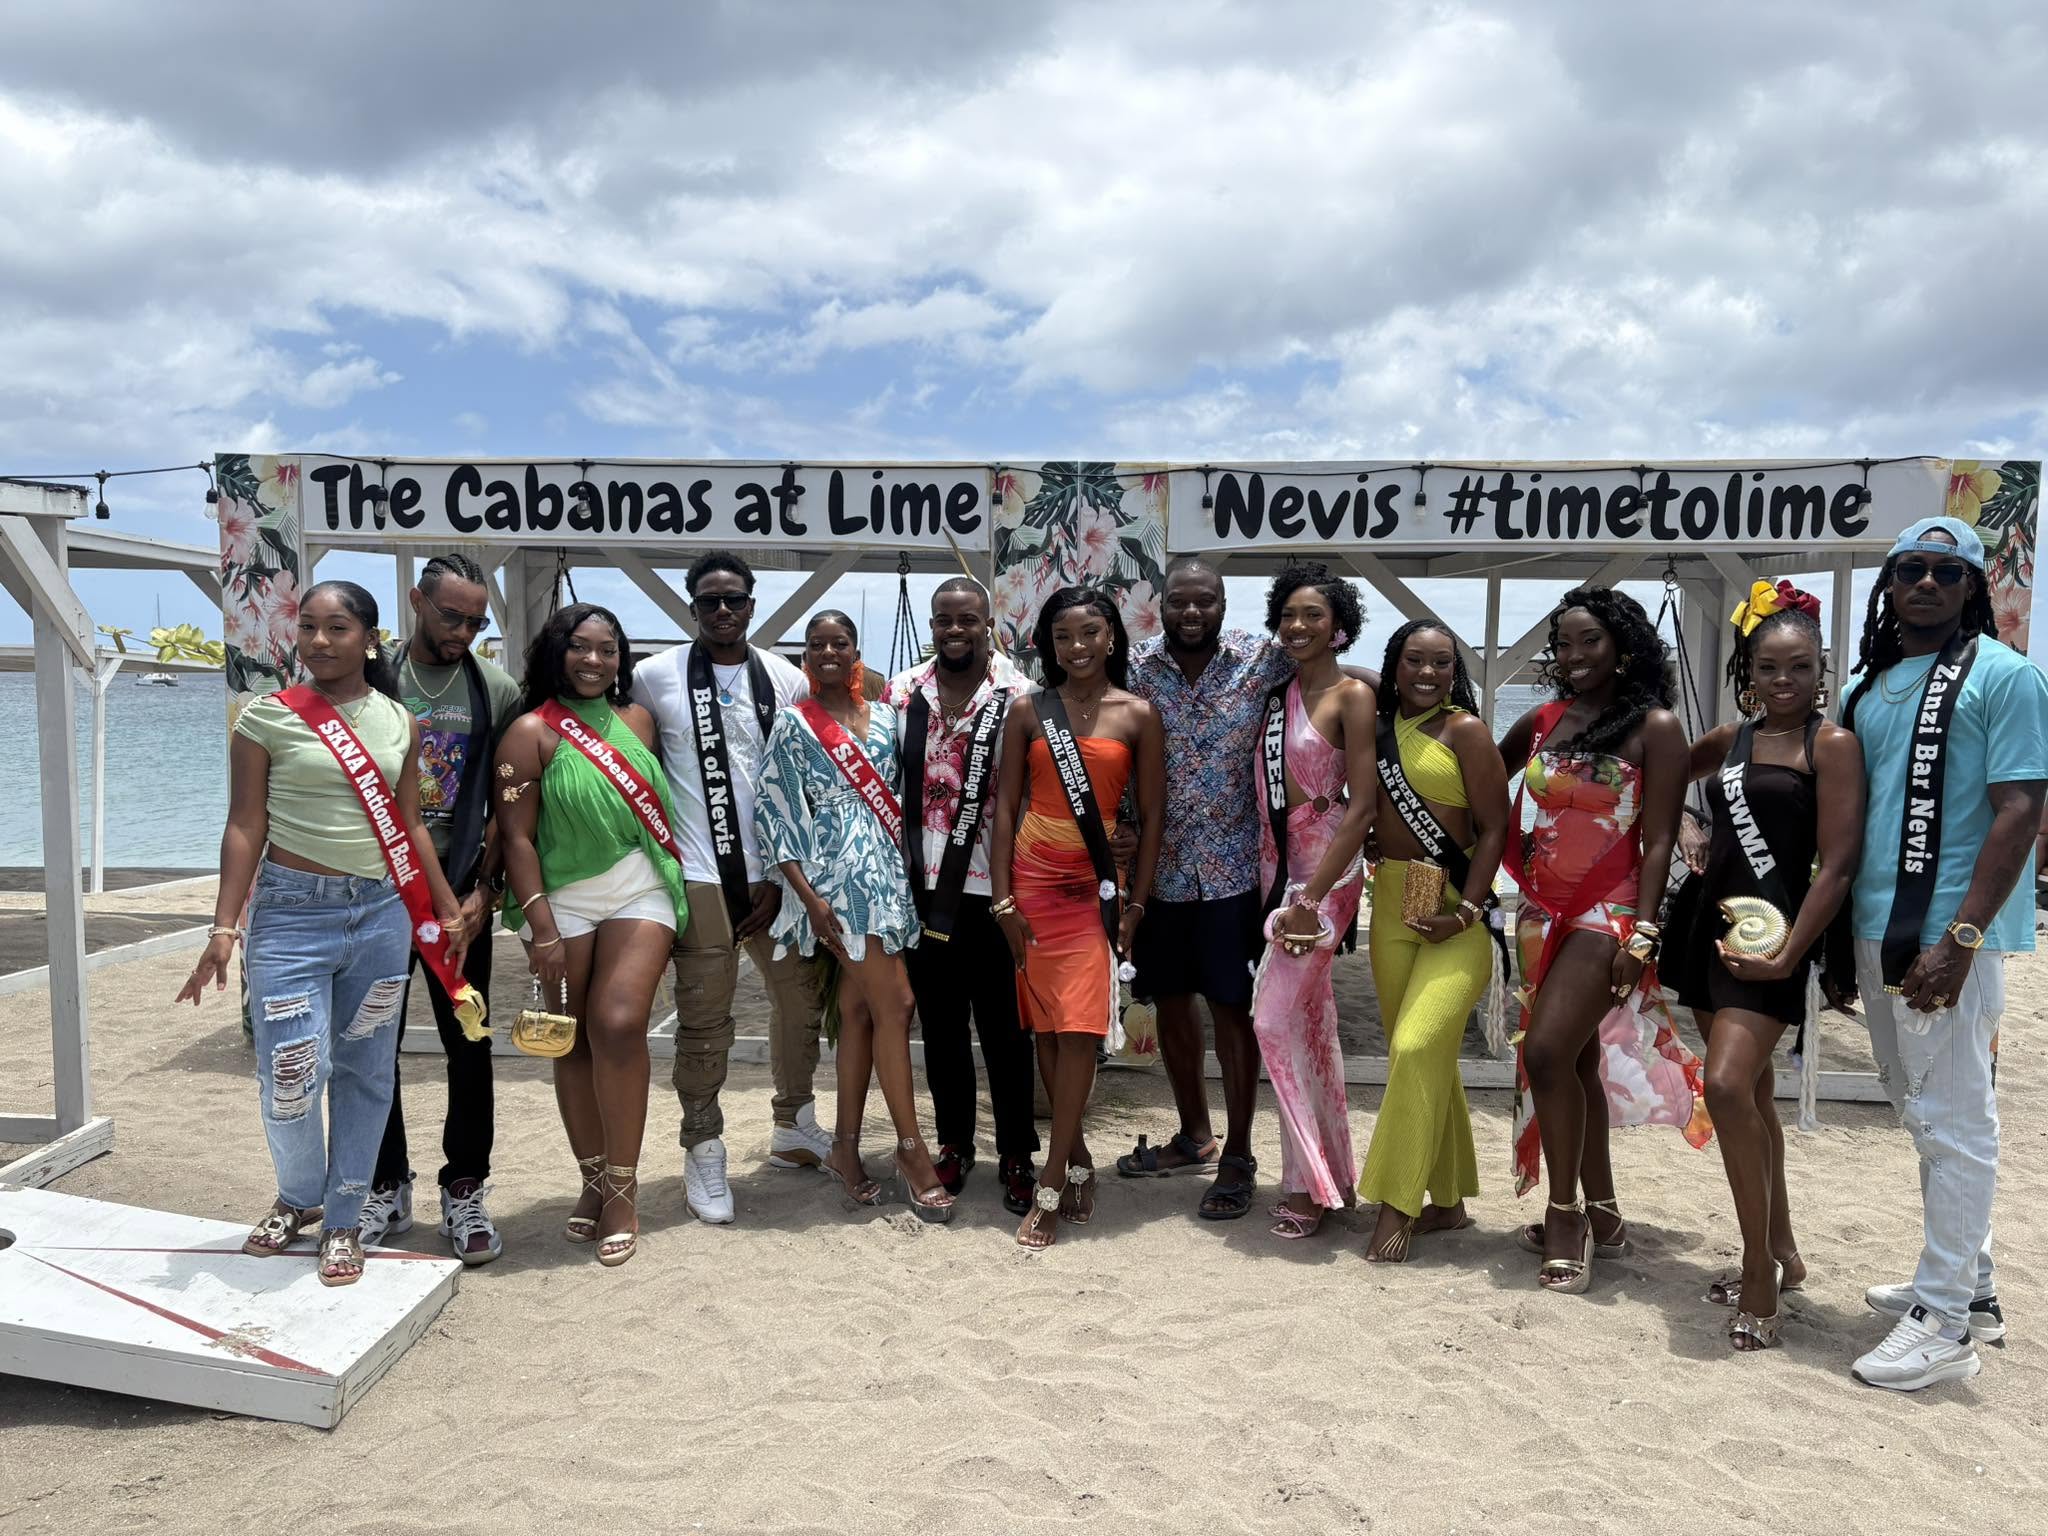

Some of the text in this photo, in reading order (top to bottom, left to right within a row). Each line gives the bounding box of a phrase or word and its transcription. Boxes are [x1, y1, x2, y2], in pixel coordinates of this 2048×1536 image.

[310, 463, 981, 536] The Cabanas at Lime
[1214, 471, 1866, 540] Nevis #timetolime
[317, 718, 420, 887] SKNA National Bank
[559, 717, 670, 844] Caribbean Lottery
[692, 686, 733, 856] Bank of Nevis
[831, 742, 902, 847] S.L. Horsfo
[964, 744, 990, 800] Heritage
[1042, 717, 1085, 816] DIGITAL DISPLAYS
[1058, 728, 1090, 793] CARIBBEAN
[1377, 758, 1443, 858] BAR & GARDEN
[1391, 763, 1446, 842] QUEEN CITY
[1905, 663, 1962, 874] Zanzi Bar Nevis
[952, 802, 979, 846] Village
[1721, 761, 1777, 880] NSWMA
